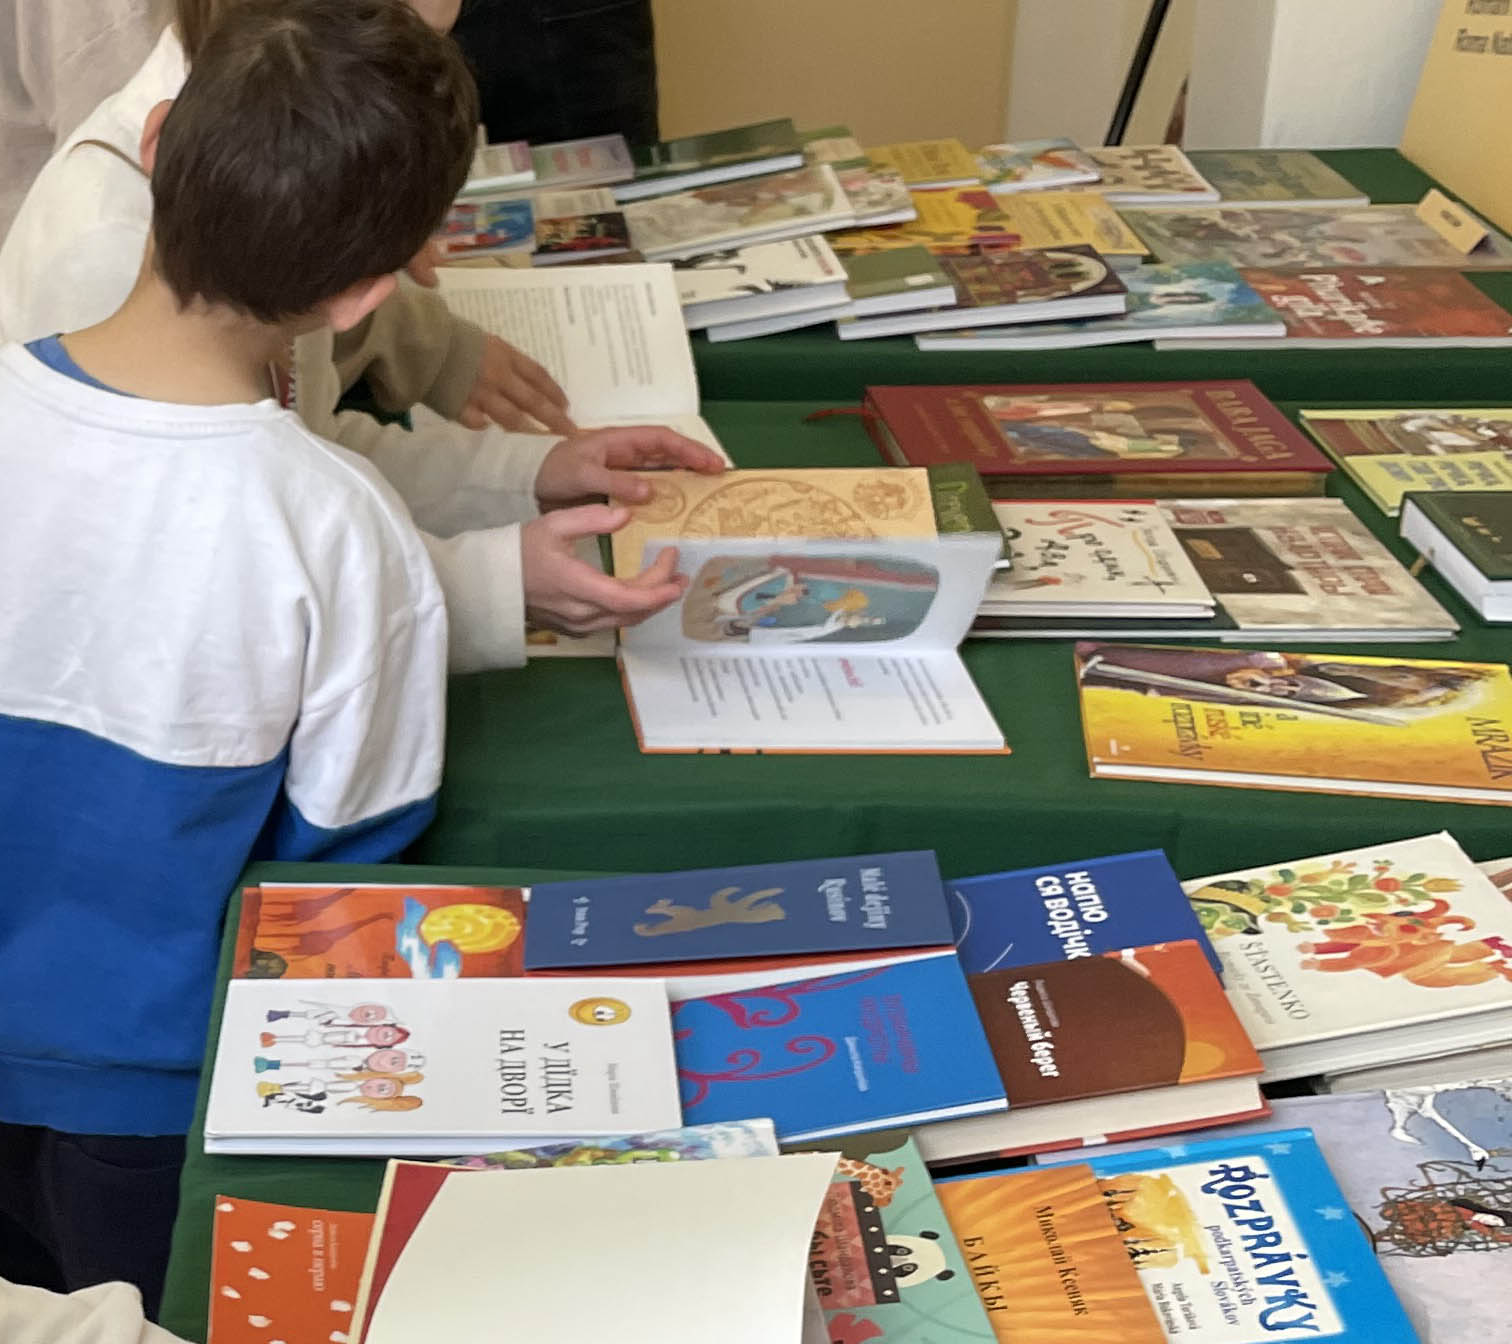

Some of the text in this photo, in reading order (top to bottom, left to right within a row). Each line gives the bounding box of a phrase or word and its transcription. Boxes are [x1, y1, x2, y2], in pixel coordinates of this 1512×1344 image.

[859, 867, 892, 930] Malé dejiny
[495, 1029, 535, 1115] НА ДВОРЇ
[538, 1041, 579, 1114] У ДЇДКА
[1034, 1206, 1072, 1265] Миколай
[1204, 1223, 1257, 1307] podkarpatských
[963, 1235, 1009, 1313] БАЙКЫ
[1210, 1280, 1244, 1327] Slovákov
